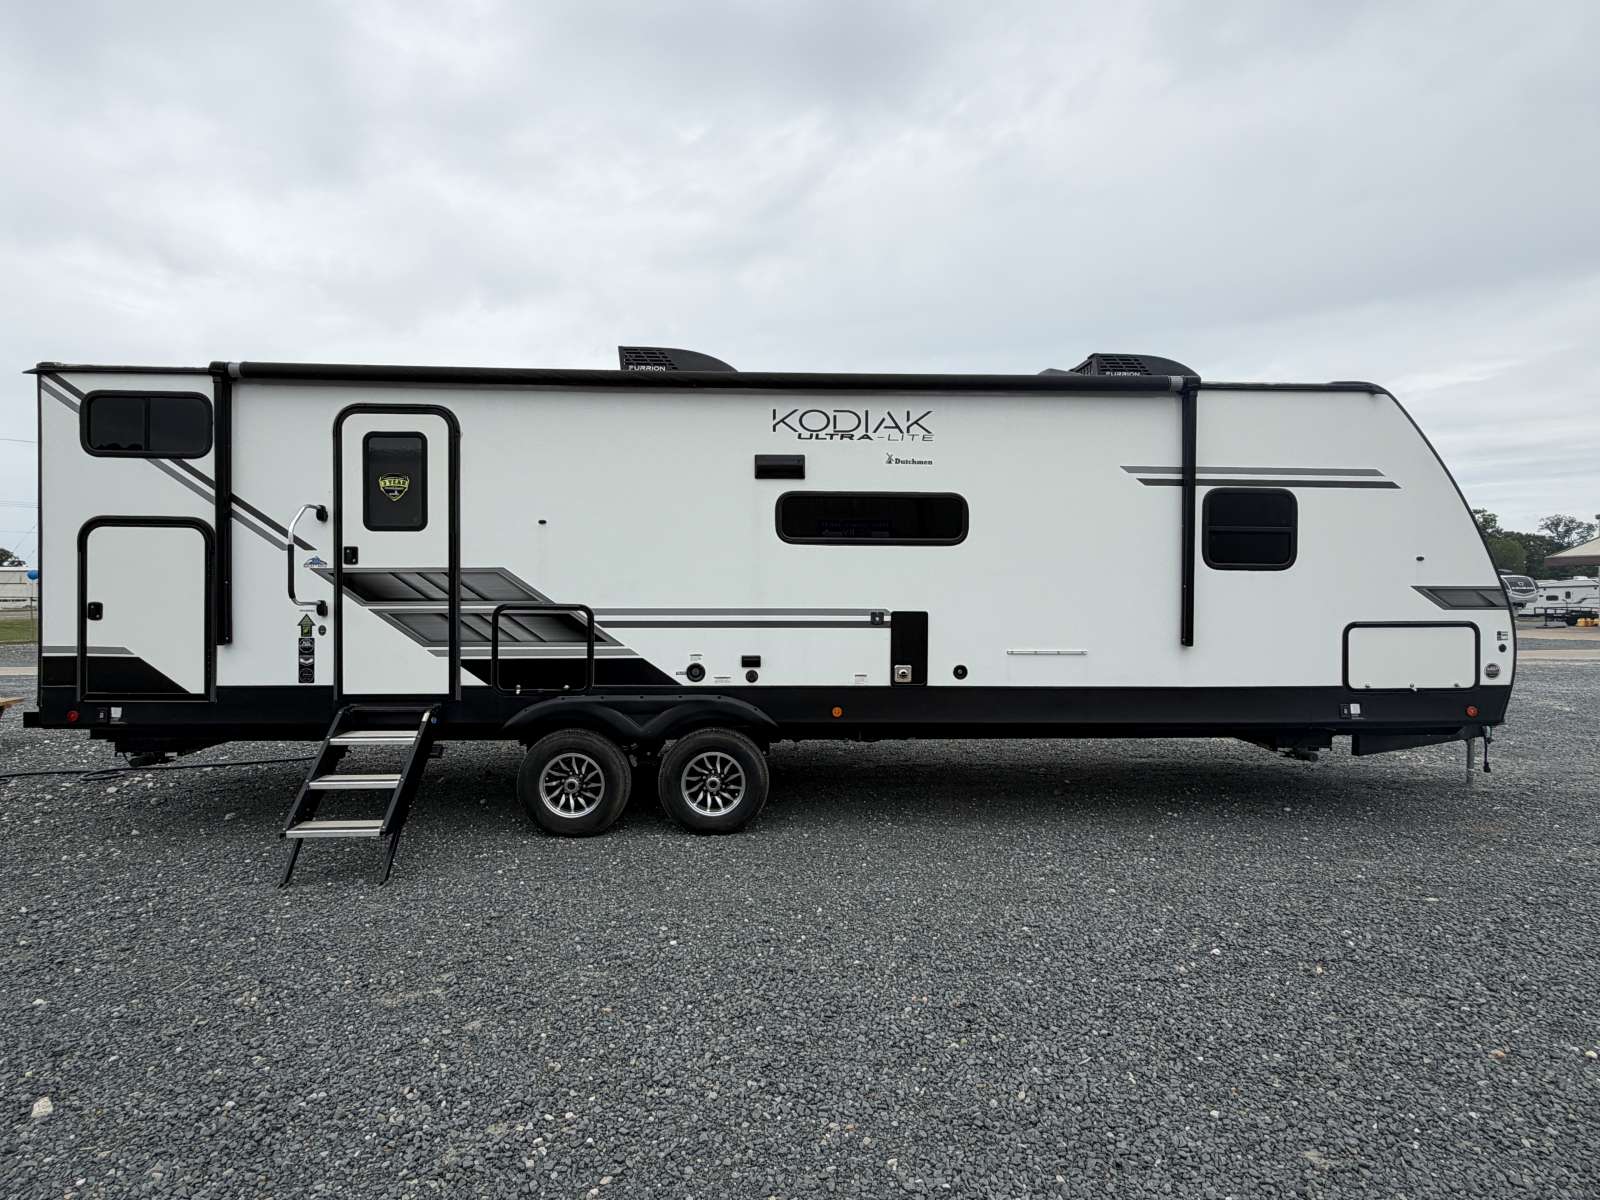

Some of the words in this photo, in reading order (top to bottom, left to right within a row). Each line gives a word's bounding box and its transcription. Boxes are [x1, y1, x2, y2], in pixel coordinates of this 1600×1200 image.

[772, 408, 934, 434] KODIAK
[797, 432, 935, 442] ULTRA-LITE
[894, 457, 933, 465] Dutchmen
